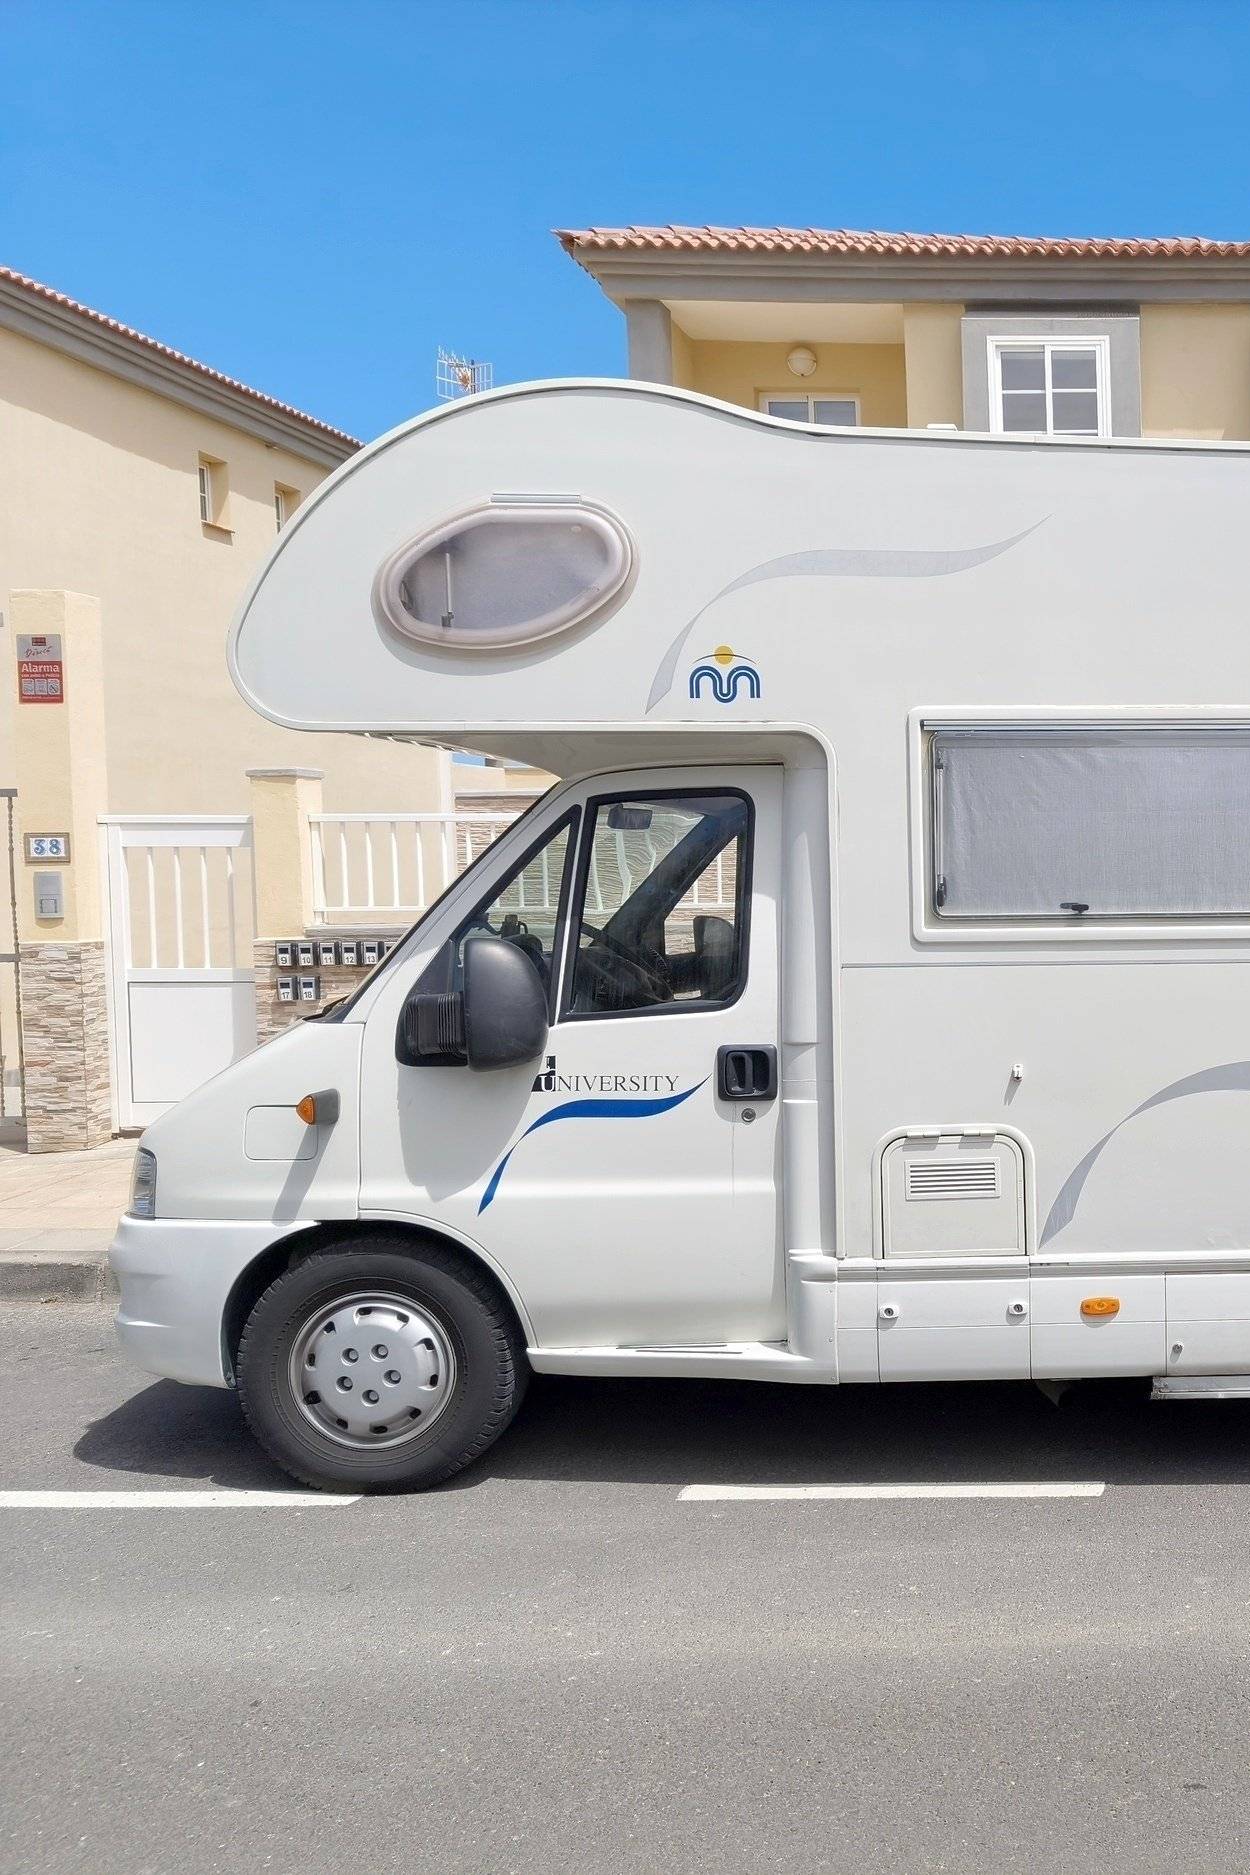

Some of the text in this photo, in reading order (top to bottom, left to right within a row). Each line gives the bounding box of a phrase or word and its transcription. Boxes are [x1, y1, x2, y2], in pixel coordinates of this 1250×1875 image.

[22, 663, 59, 672] Alarma
[34, 839, 61, 855] 38
[280, 957, 288, 965] 9
[366, 955, 376, 963] 13
[303, 991, 313, 999] 18
[540, 1074, 680, 1092] UNIVERSITY
